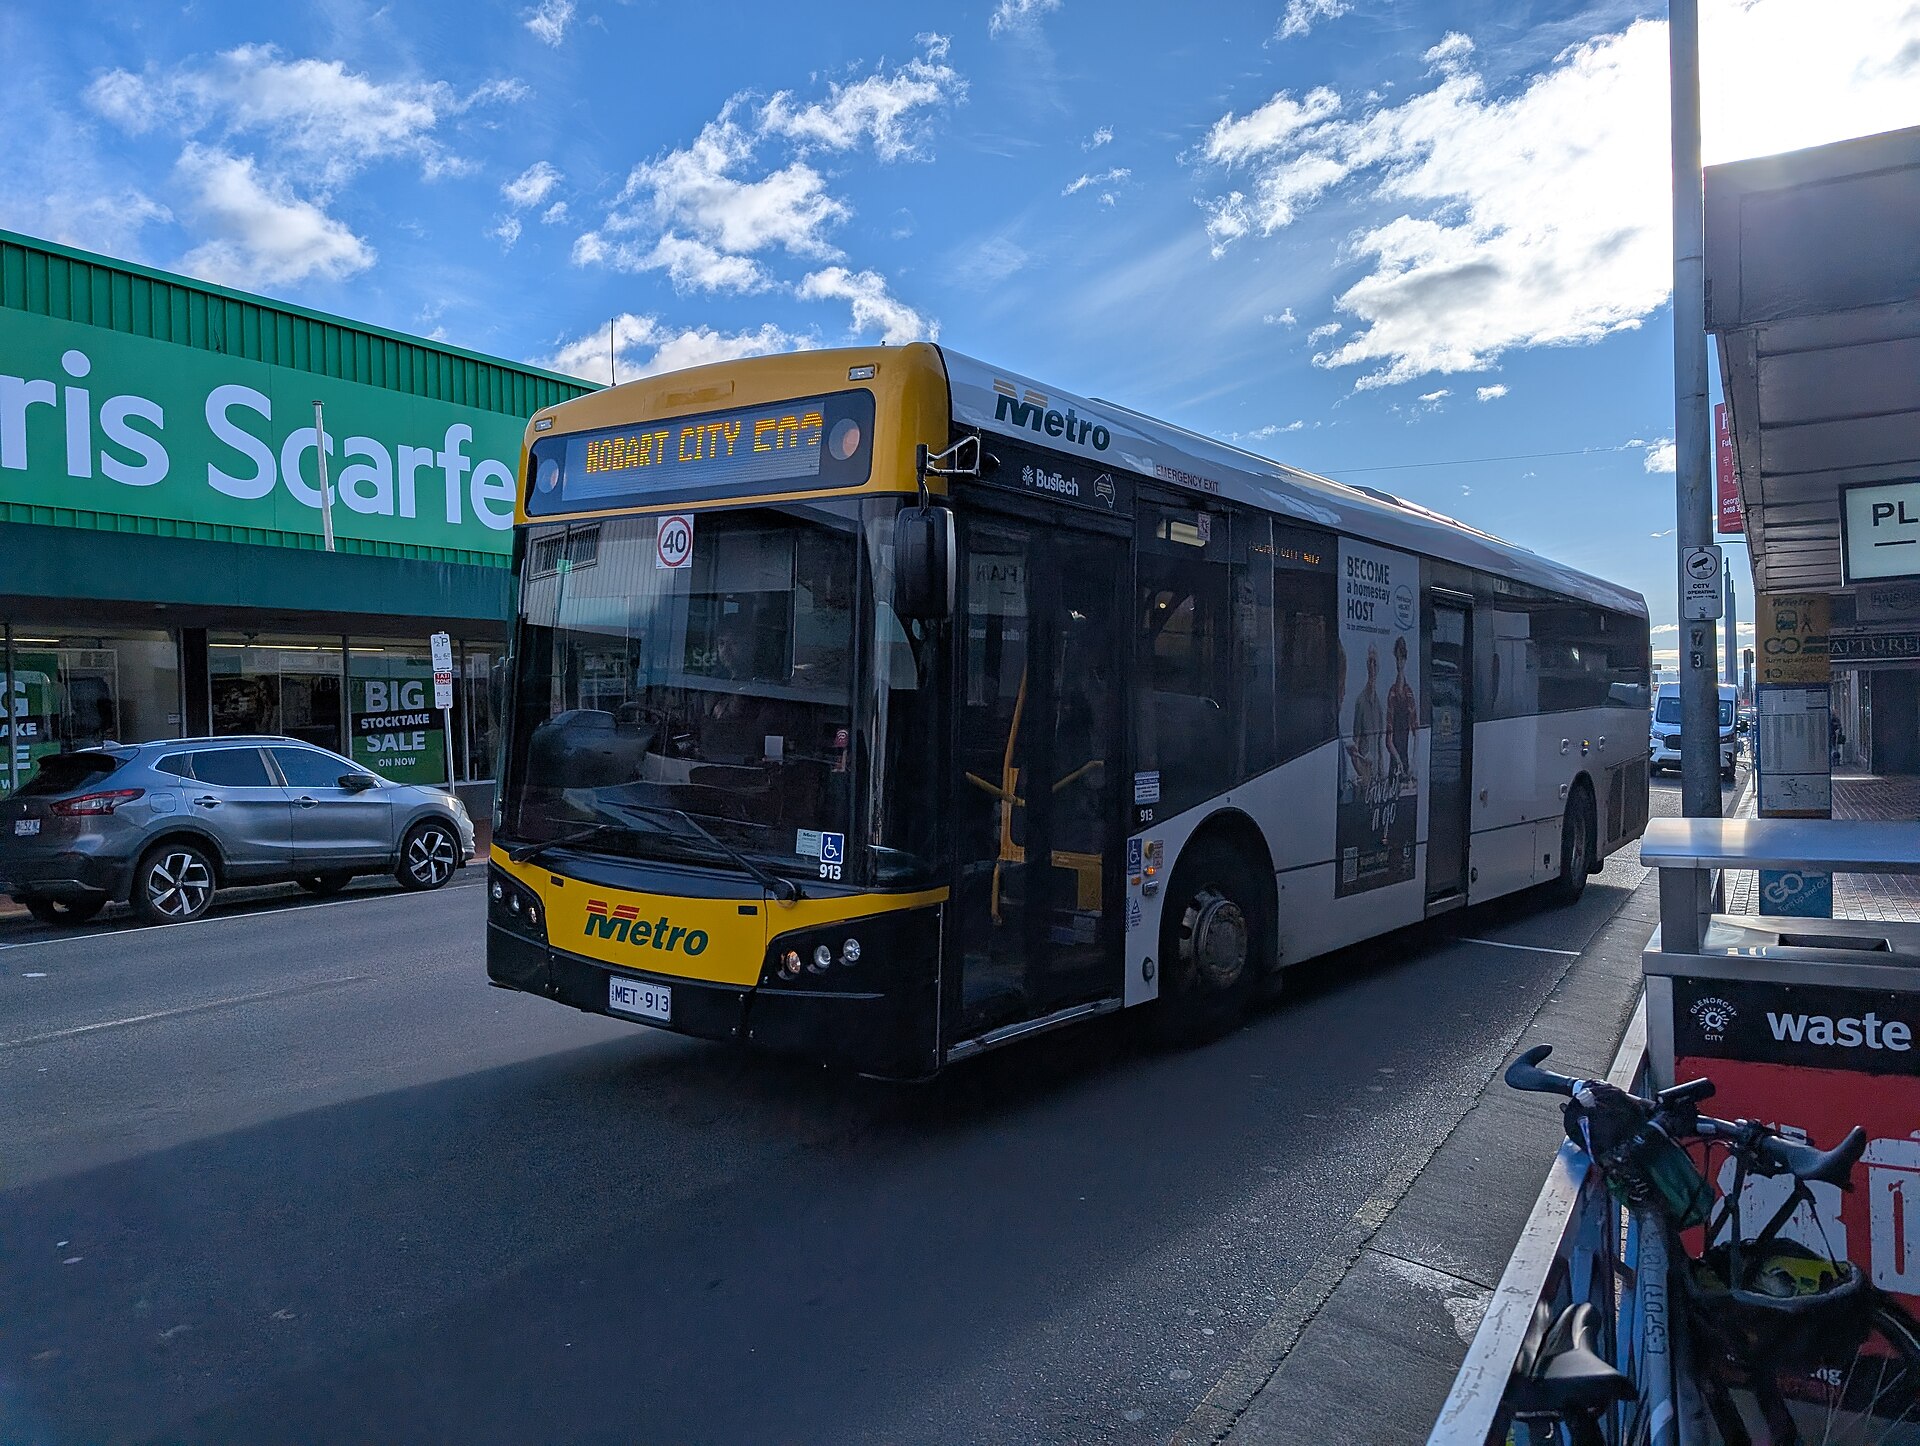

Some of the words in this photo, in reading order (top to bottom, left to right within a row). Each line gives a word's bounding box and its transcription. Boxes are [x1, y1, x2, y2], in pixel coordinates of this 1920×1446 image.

[993, 379, 1111, 451] Metro
[205, 384, 517, 530] Scarfe
[586, 431, 669, 473] HOBART
[678, 420, 741, 461] CITY
[1036, 468, 1079, 497] BusTech
[1156, 464, 1202, 488] EMERGENCY
[1204, 478, 1219, 493] EXIT
[662, 529, 687, 554] 40
[1346, 555, 1390, 585] BECOME
[1346, 581, 1352, 594] a
[1353, 579, 1391, 605] homestay
[1347, 598, 1375, 622] HOST
[365, 681, 425, 712] BIG
[361, 714, 430, 729] STOCKTAKE
[366, 731, 426, 753] SALE
[378, 758, 392, 767] ON
[394, 757, 416, 767] NOW
[1140, 808, 1153, 821] 913
[819, 864, 842, 880] 913
[584, 899, 709, 956] Metro
[1690, 997, 1737, 1016] GLENORCHY
[1766, 1012, 1912, 1051] waste
